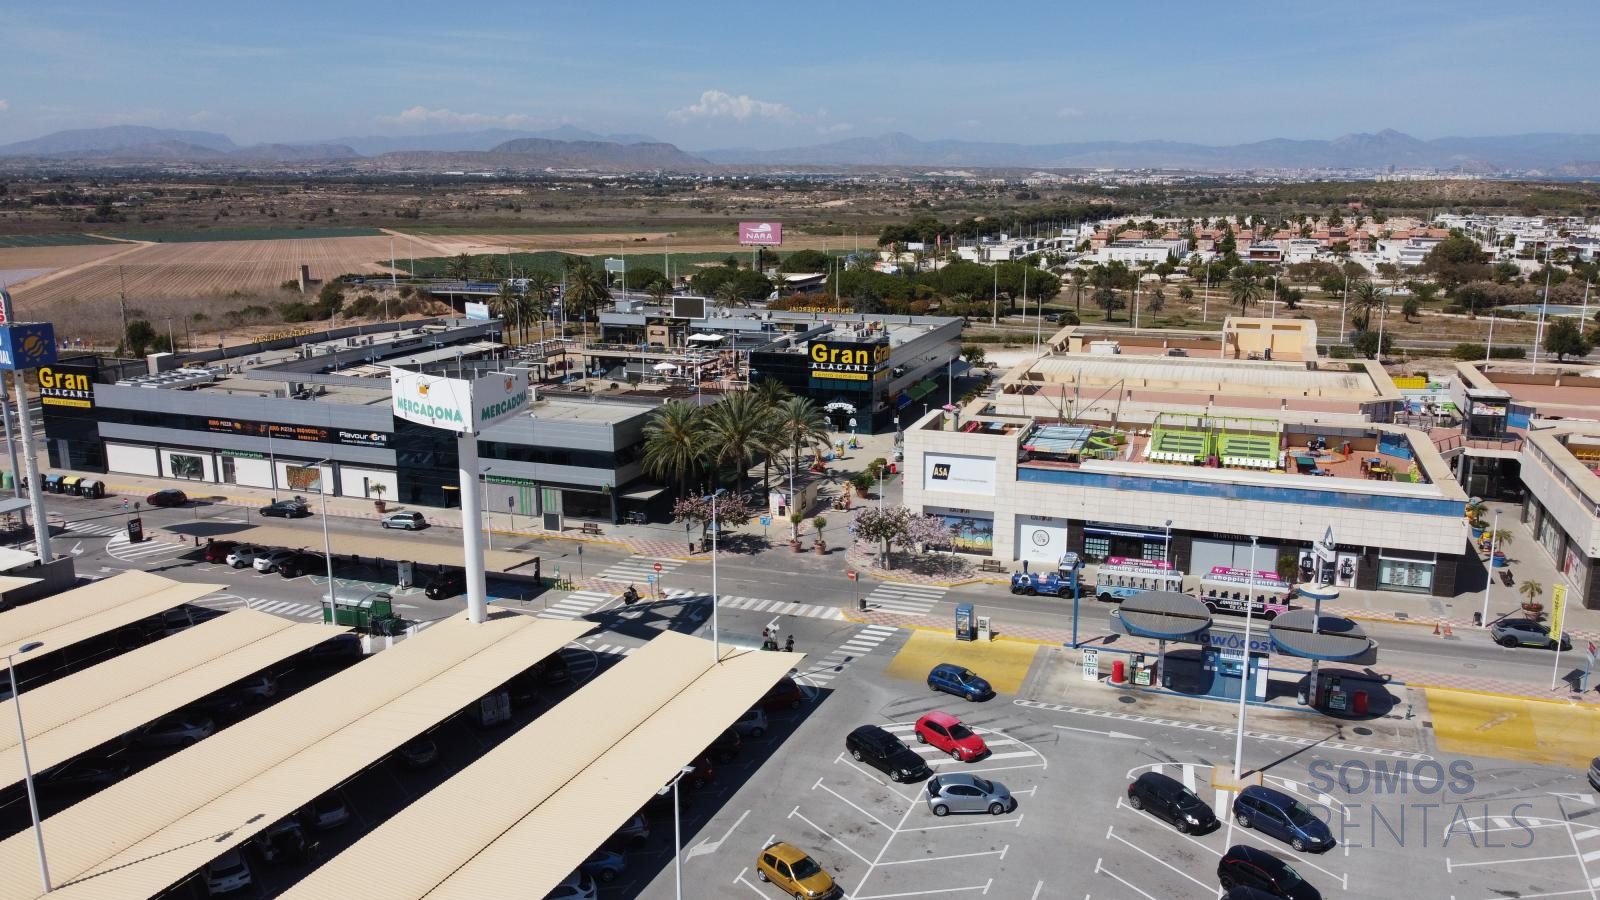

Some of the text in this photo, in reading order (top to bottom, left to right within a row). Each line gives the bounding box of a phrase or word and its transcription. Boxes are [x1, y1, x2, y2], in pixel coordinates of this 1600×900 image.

[811, 343, 868, 365] Gran
[812, 362, 868, 371] ALACANT
[39, 367, 89, 391] Gran
[41, 387, 90, 398] ALACANT
[397, 397, 463, 422] MERCADONA
[481, 390, 527, 421] MERCADONA
[339, 431, 387, 442] Flavour Grill
[933, 466, 948, 477] ASA
[1109, 564, 1133, 572] centro
[1213, 575, 1250, 584] shopping
[1194, 632, 1226, 646] low
